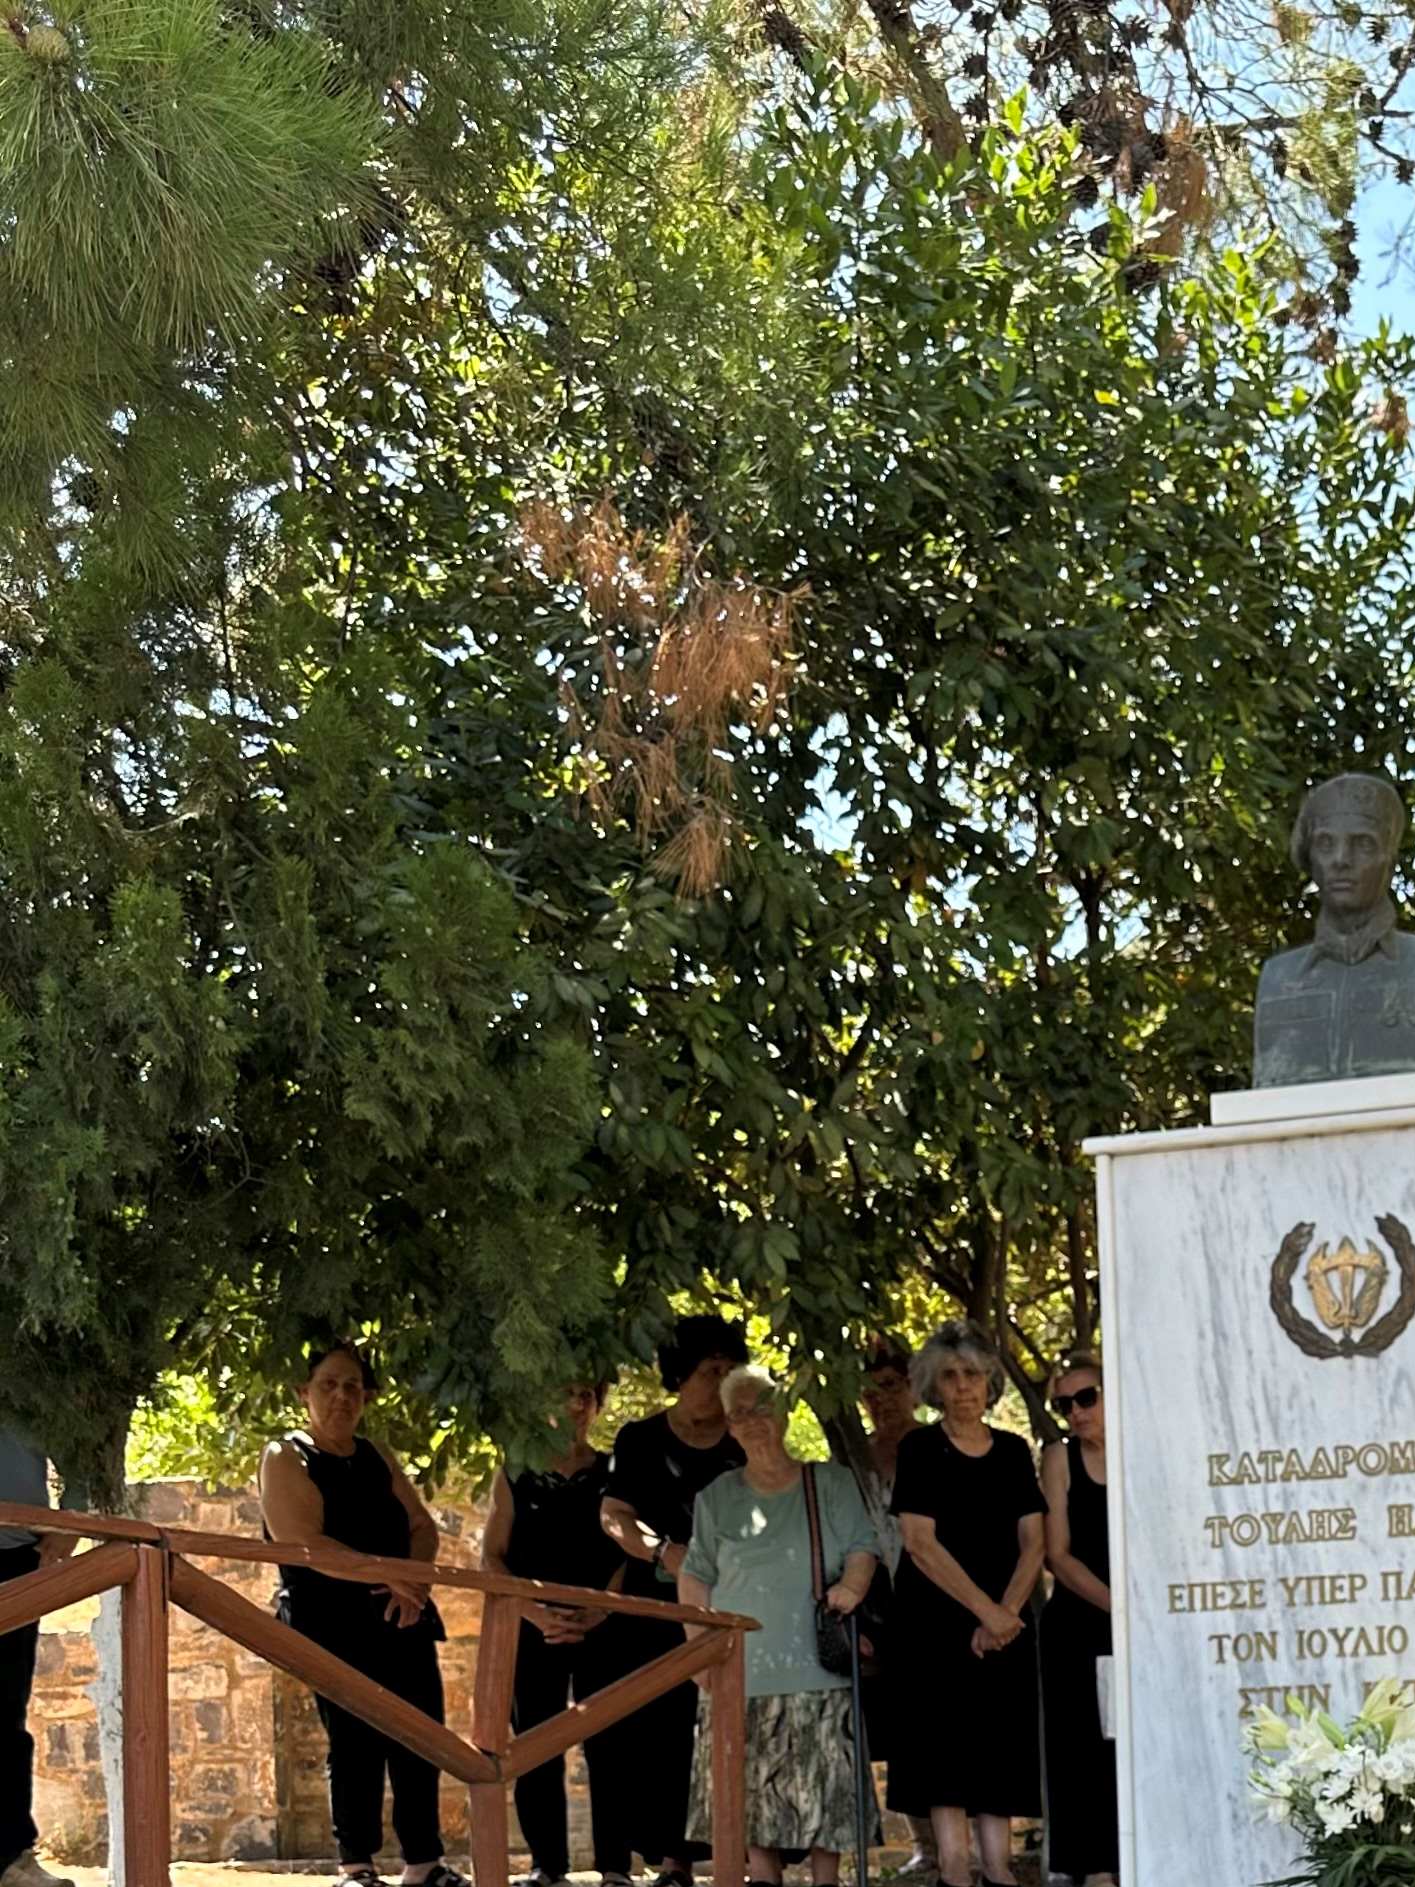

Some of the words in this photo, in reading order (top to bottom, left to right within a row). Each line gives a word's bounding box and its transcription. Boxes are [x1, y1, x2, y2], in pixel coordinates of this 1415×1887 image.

[1204, 1508, 1357, 1549] ΤΟΥΛΗΣ
[1168, 1579, 1267, 1614] ΕΠΕΣΕ
[1279, 1573, 1367, 1608] ΥΠΕΡ
[1208, 1631, 1279, 1665] ΤΟΝ
[1296, 1624, 1408, 1661] ΙΟΥΛΙΟ
